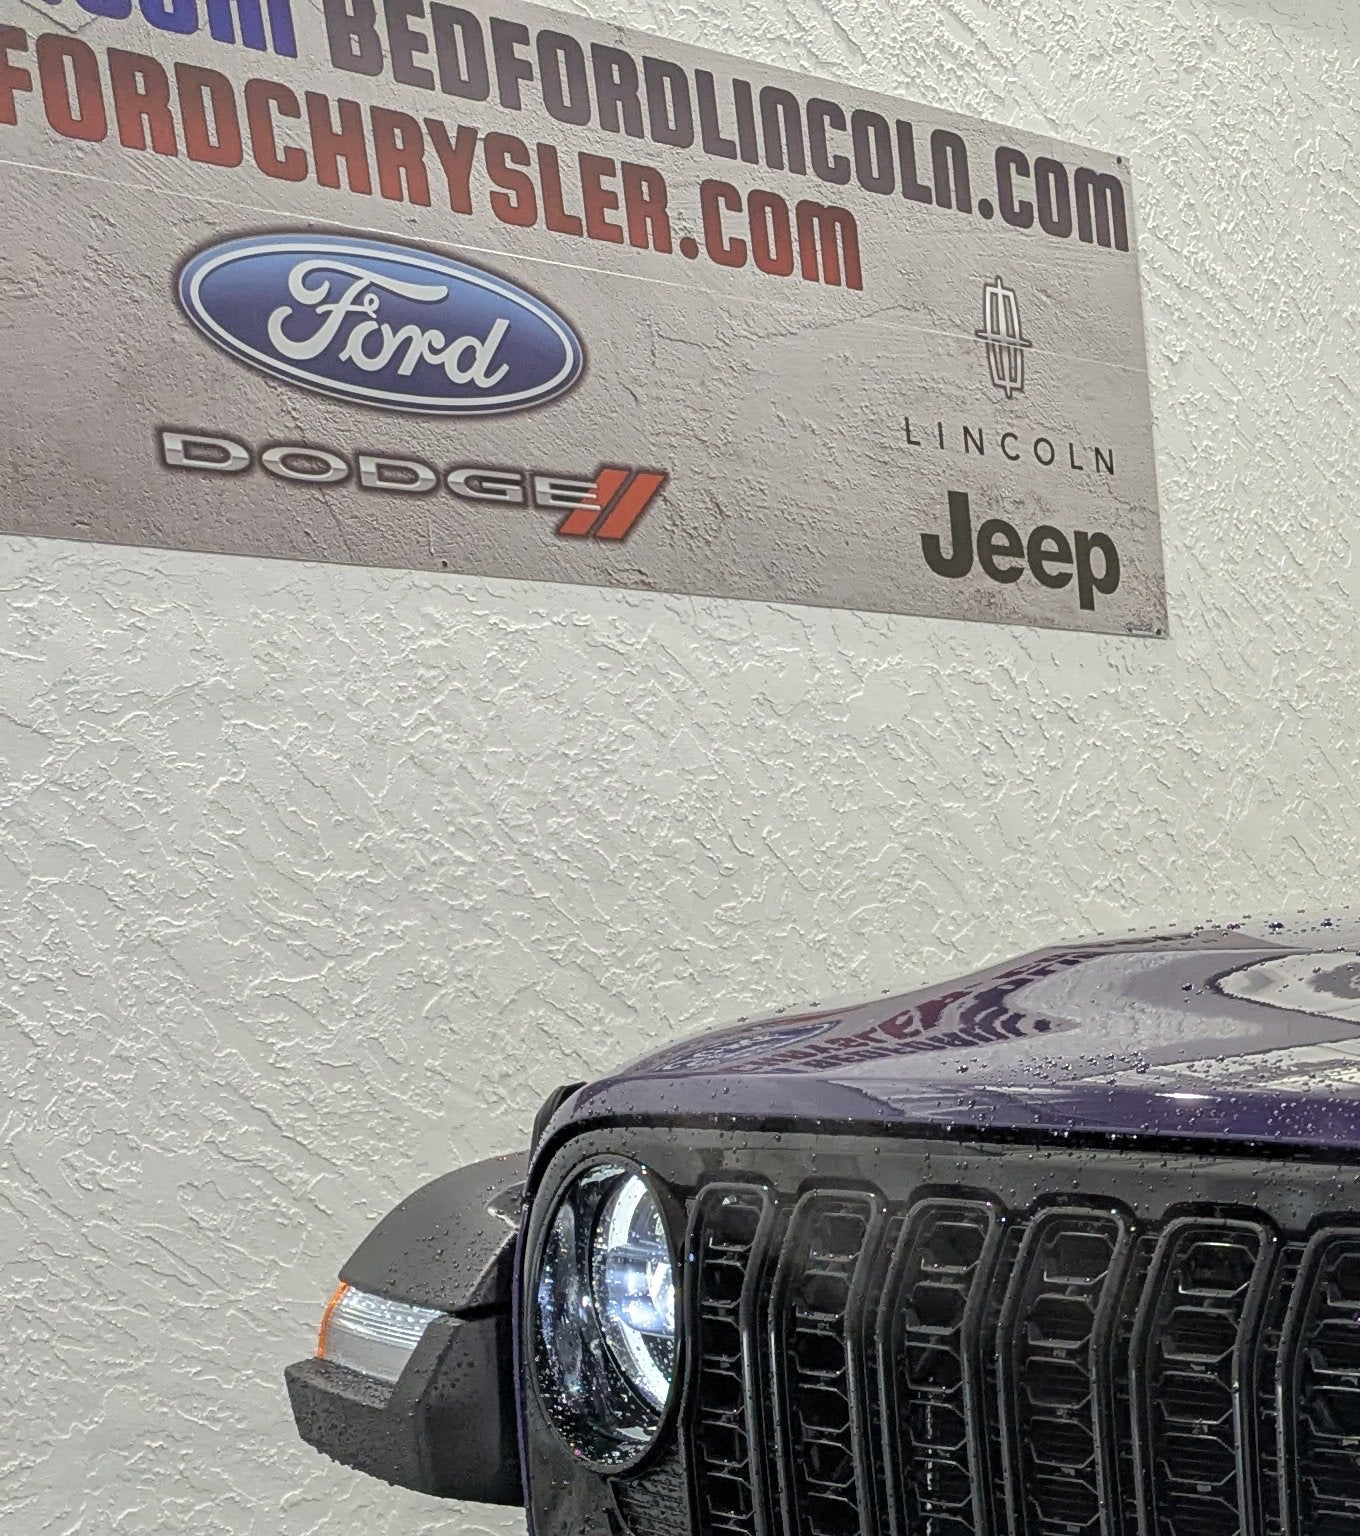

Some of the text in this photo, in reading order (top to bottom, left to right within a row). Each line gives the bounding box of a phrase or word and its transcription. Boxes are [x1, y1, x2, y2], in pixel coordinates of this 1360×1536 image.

[267, 259, 510, 388] Ford
[161, 431, 602, 512] DODGE
[905, 416, 1115, 476] LINCOLN
[920, 490, 1121, 611] Jeep
